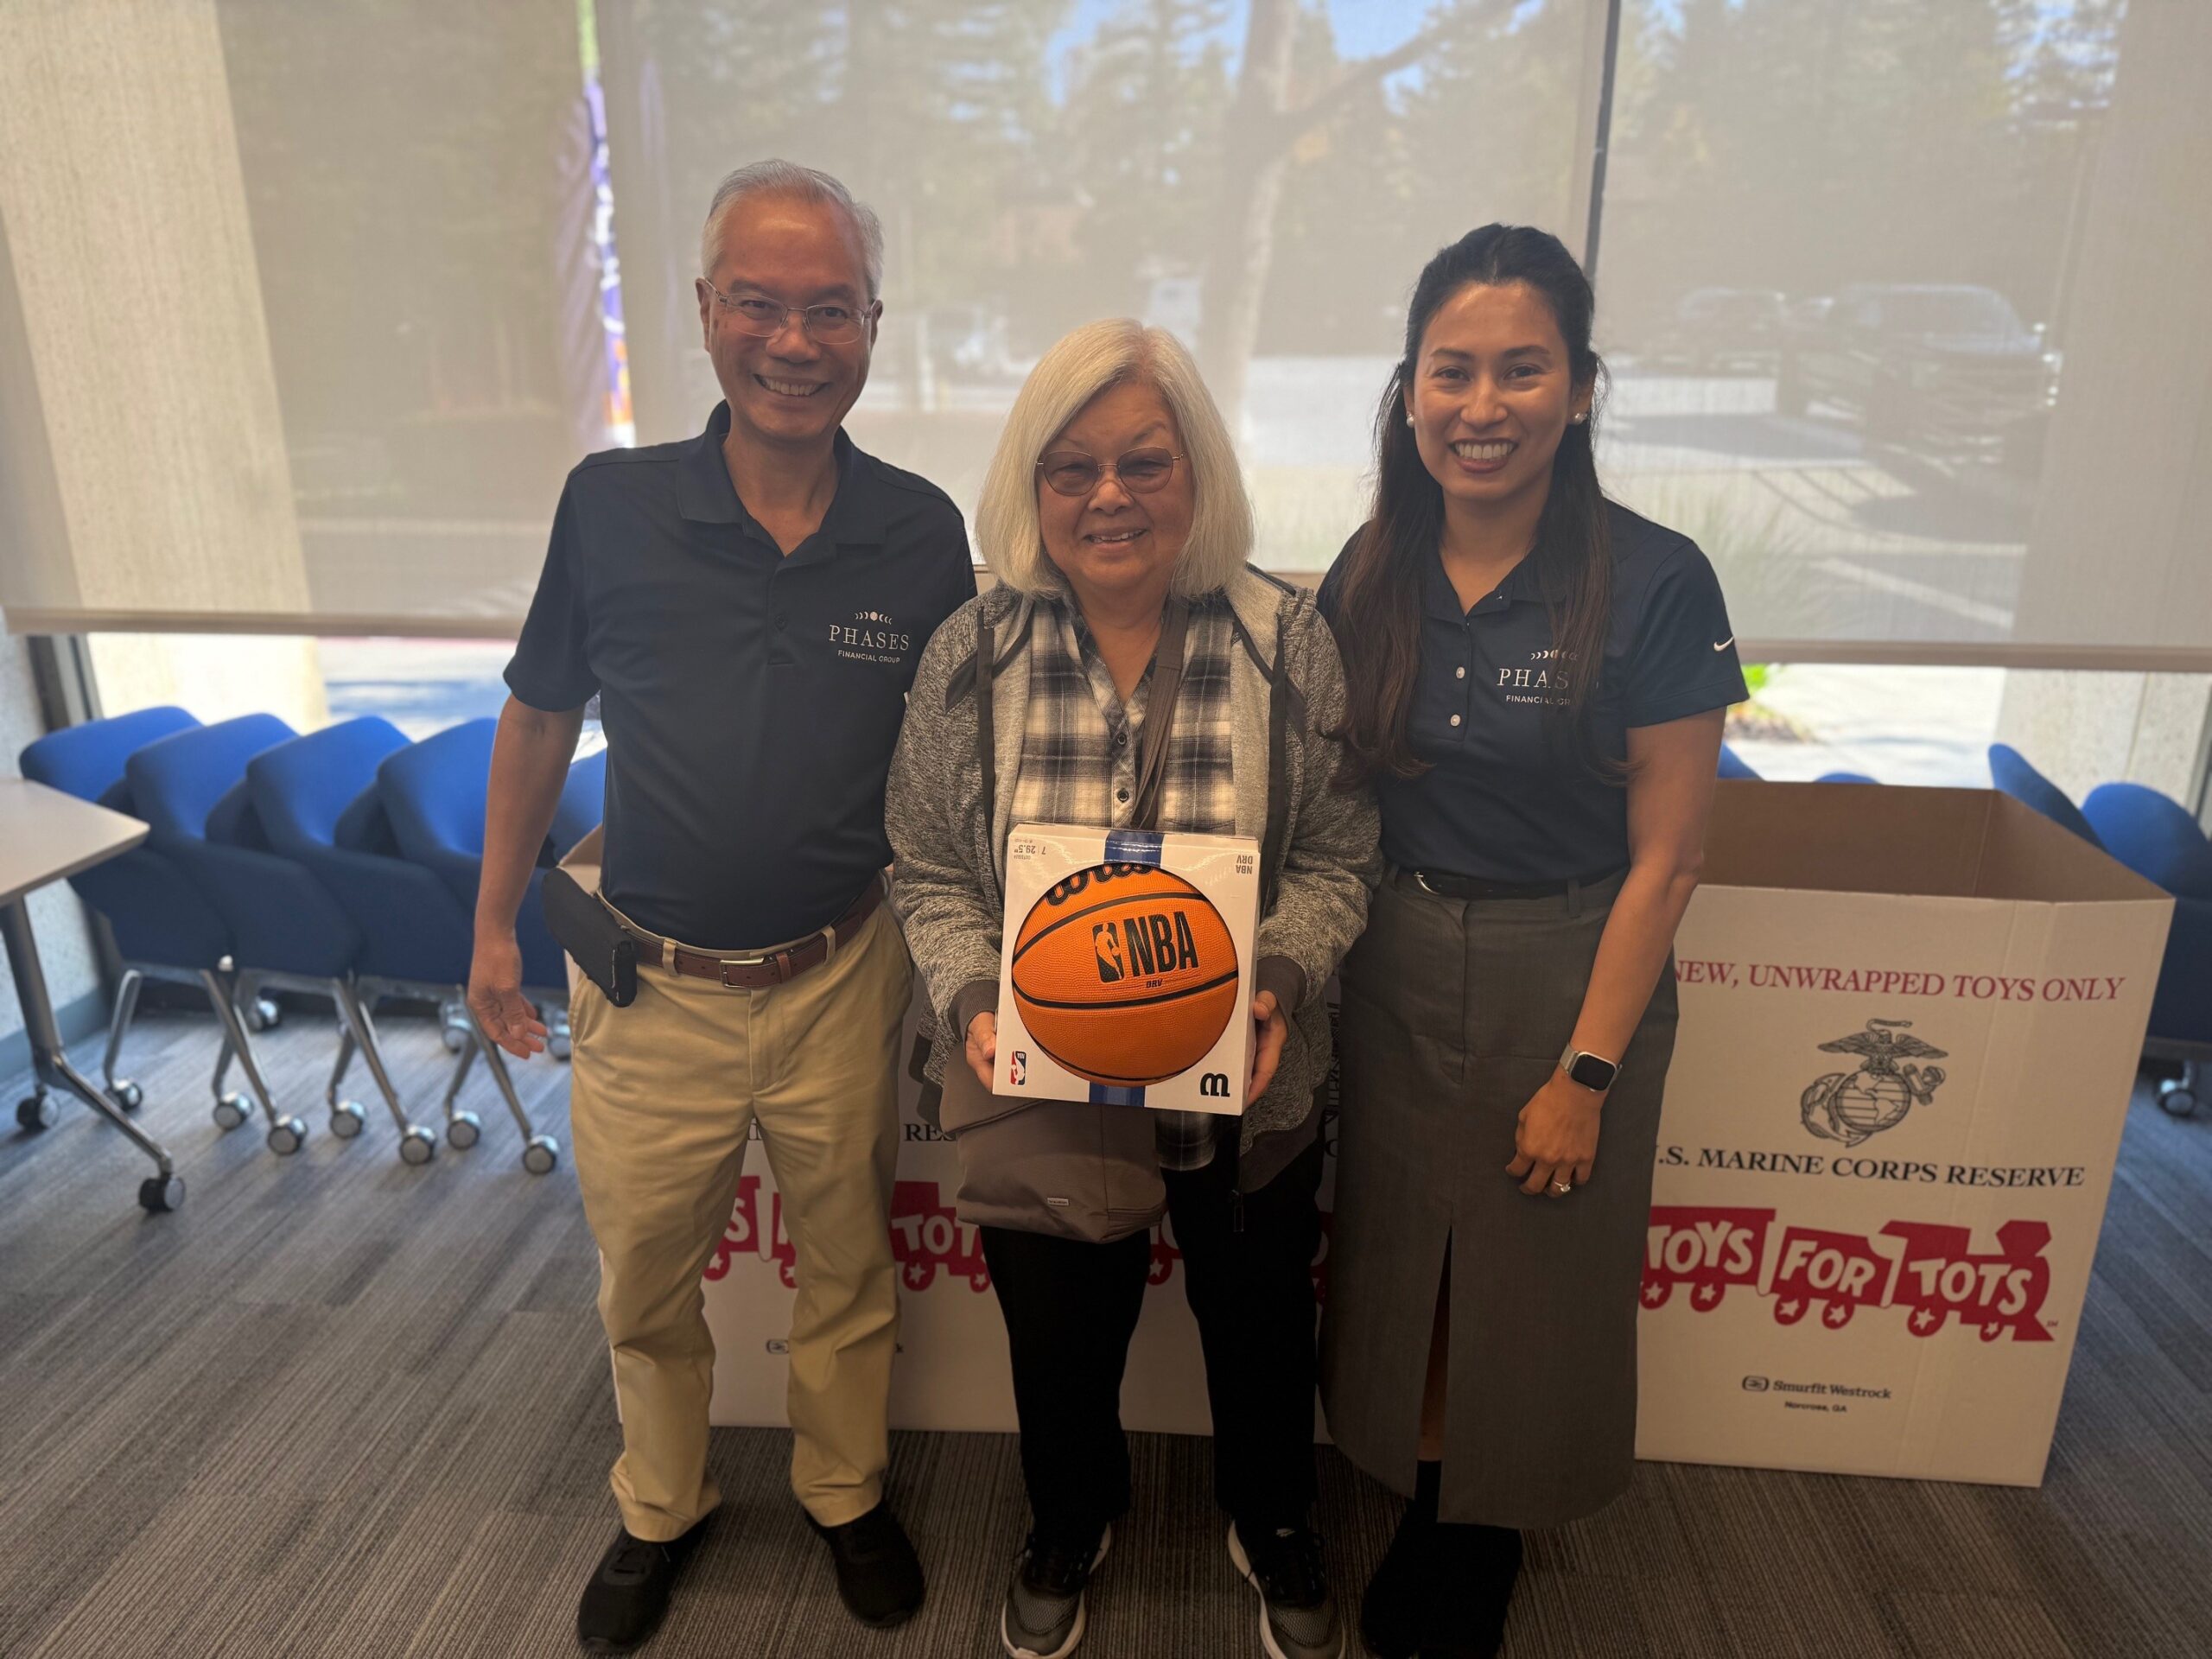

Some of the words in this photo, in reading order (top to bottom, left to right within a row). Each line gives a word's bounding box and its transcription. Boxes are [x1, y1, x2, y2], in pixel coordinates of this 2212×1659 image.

[829, 624, 909, 651] PHASES
[838, 650, 877, 662] FINANCIAL
[879, 655, 900, 664] GROUP
[1497, 668, 1570, 690] PHAS
[1236, 855, 1253, 865] DRV
[1236, 865, 1253, 874] NBA
[1123, 911, 1198, 976] NBA
[1749, 963, 1945, 996] UNWRAPPED
[1953, 975, 2035, 1001] TOYS
[2042, 976, 2126, 1001] ONLY
[1697, 1147, 1823, 1176] MARINE
[1831, 1156, 1937, 1184] CORPS
[1945, 1164, 2085, 1188] RESERVE
[891, 1213, 985, 1258] TOT
[1648, 1220, 1754, 1275] TOYS
[1780, 1240, 1875, 1297] FOR
[1909, 1258, 2032, 1316] TOTS
[1772, 1380, 1827, 1395] Smurfit
[1829, 1384, 1892, 1399] Westrock
